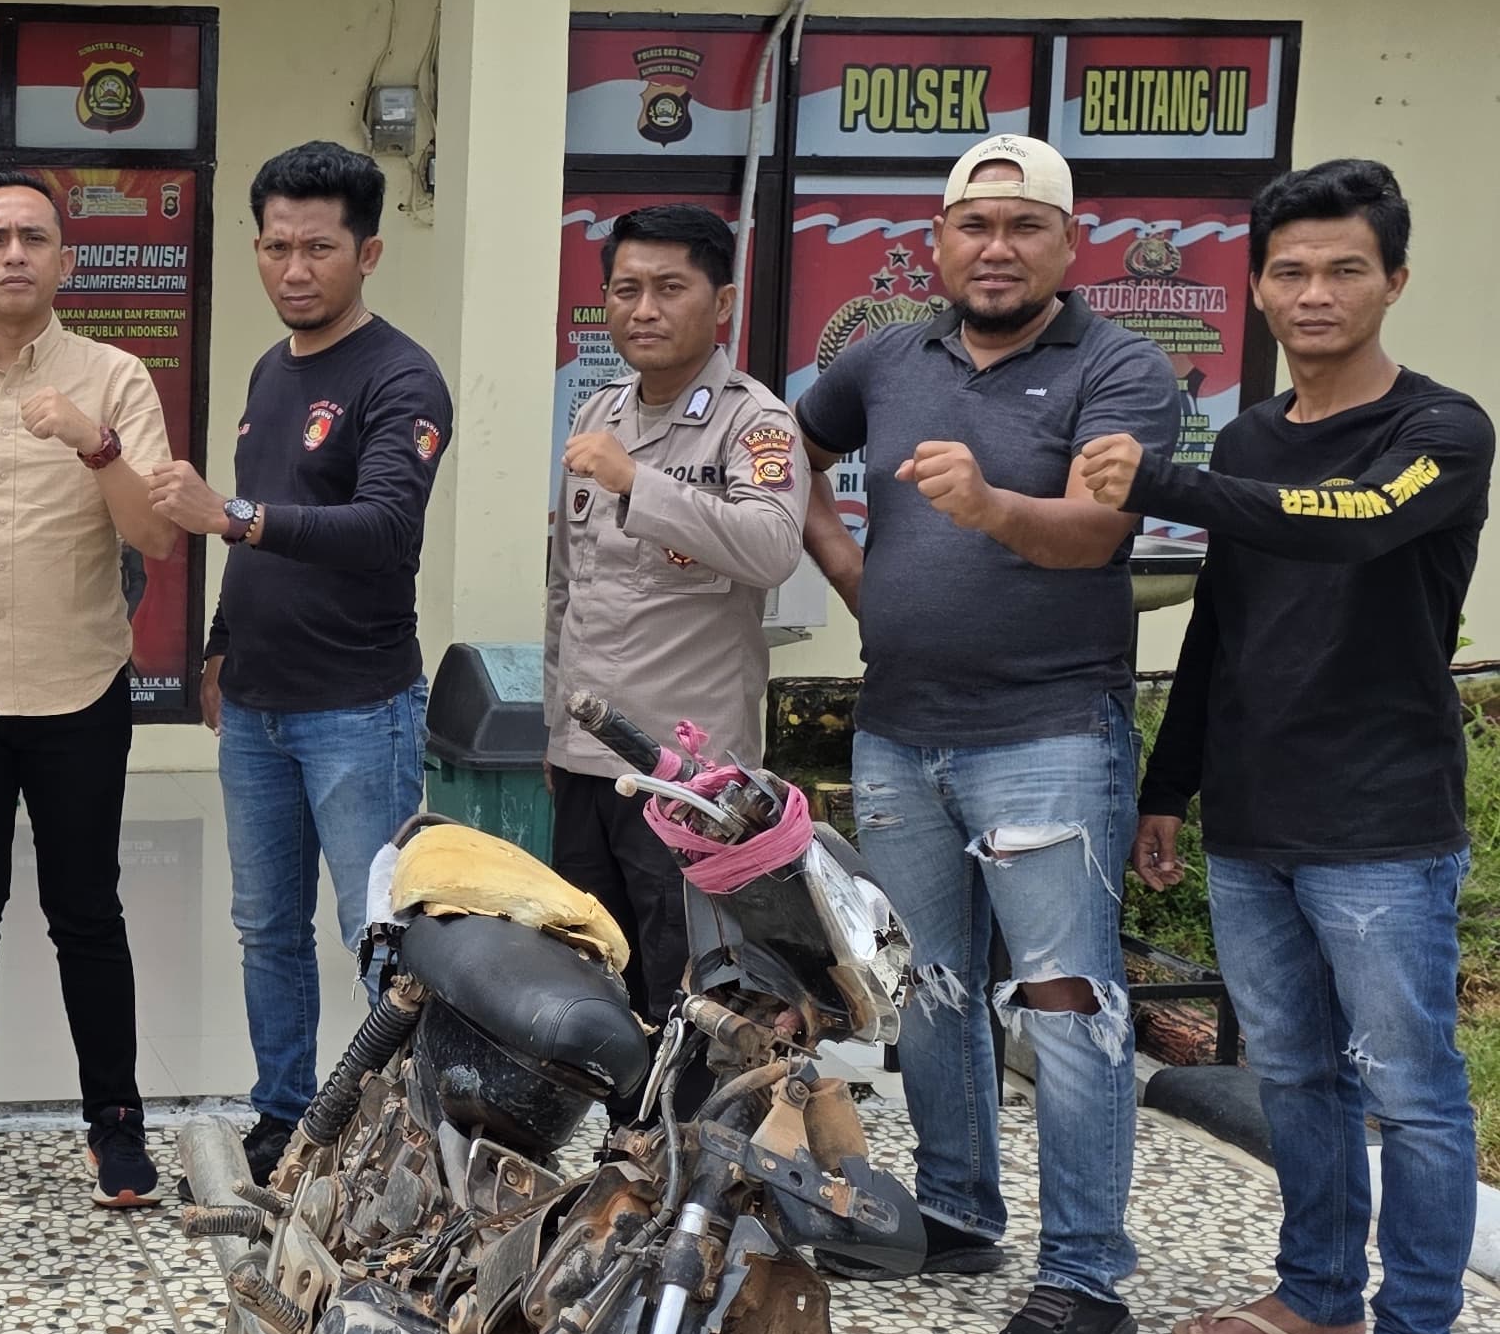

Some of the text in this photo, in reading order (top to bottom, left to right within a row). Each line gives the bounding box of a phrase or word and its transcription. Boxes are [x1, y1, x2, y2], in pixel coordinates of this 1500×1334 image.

[843, 67, 988, 130] POLSEK
[1083, 69, 1248, 132] BELITANG III
[141, 246, 188, 268] WISH
[74, 274, 136, 290] SUMATERA
[137, 275, 187, 290] SELATAN
[1137, 288, 1225, 312] PRASETYA
[88, 310, 123, 320] ARAHAN
[124, 310, 143, 320] DAN
[144, 310, 186, 321] PERINTAH
[76, 326, 125, 337] REPUBLIK
[127, 326, 179, 337] INDONESIA
[579, 345, 611, 355] BANGSA
[579, 357, 621, 367] TERHADAP
